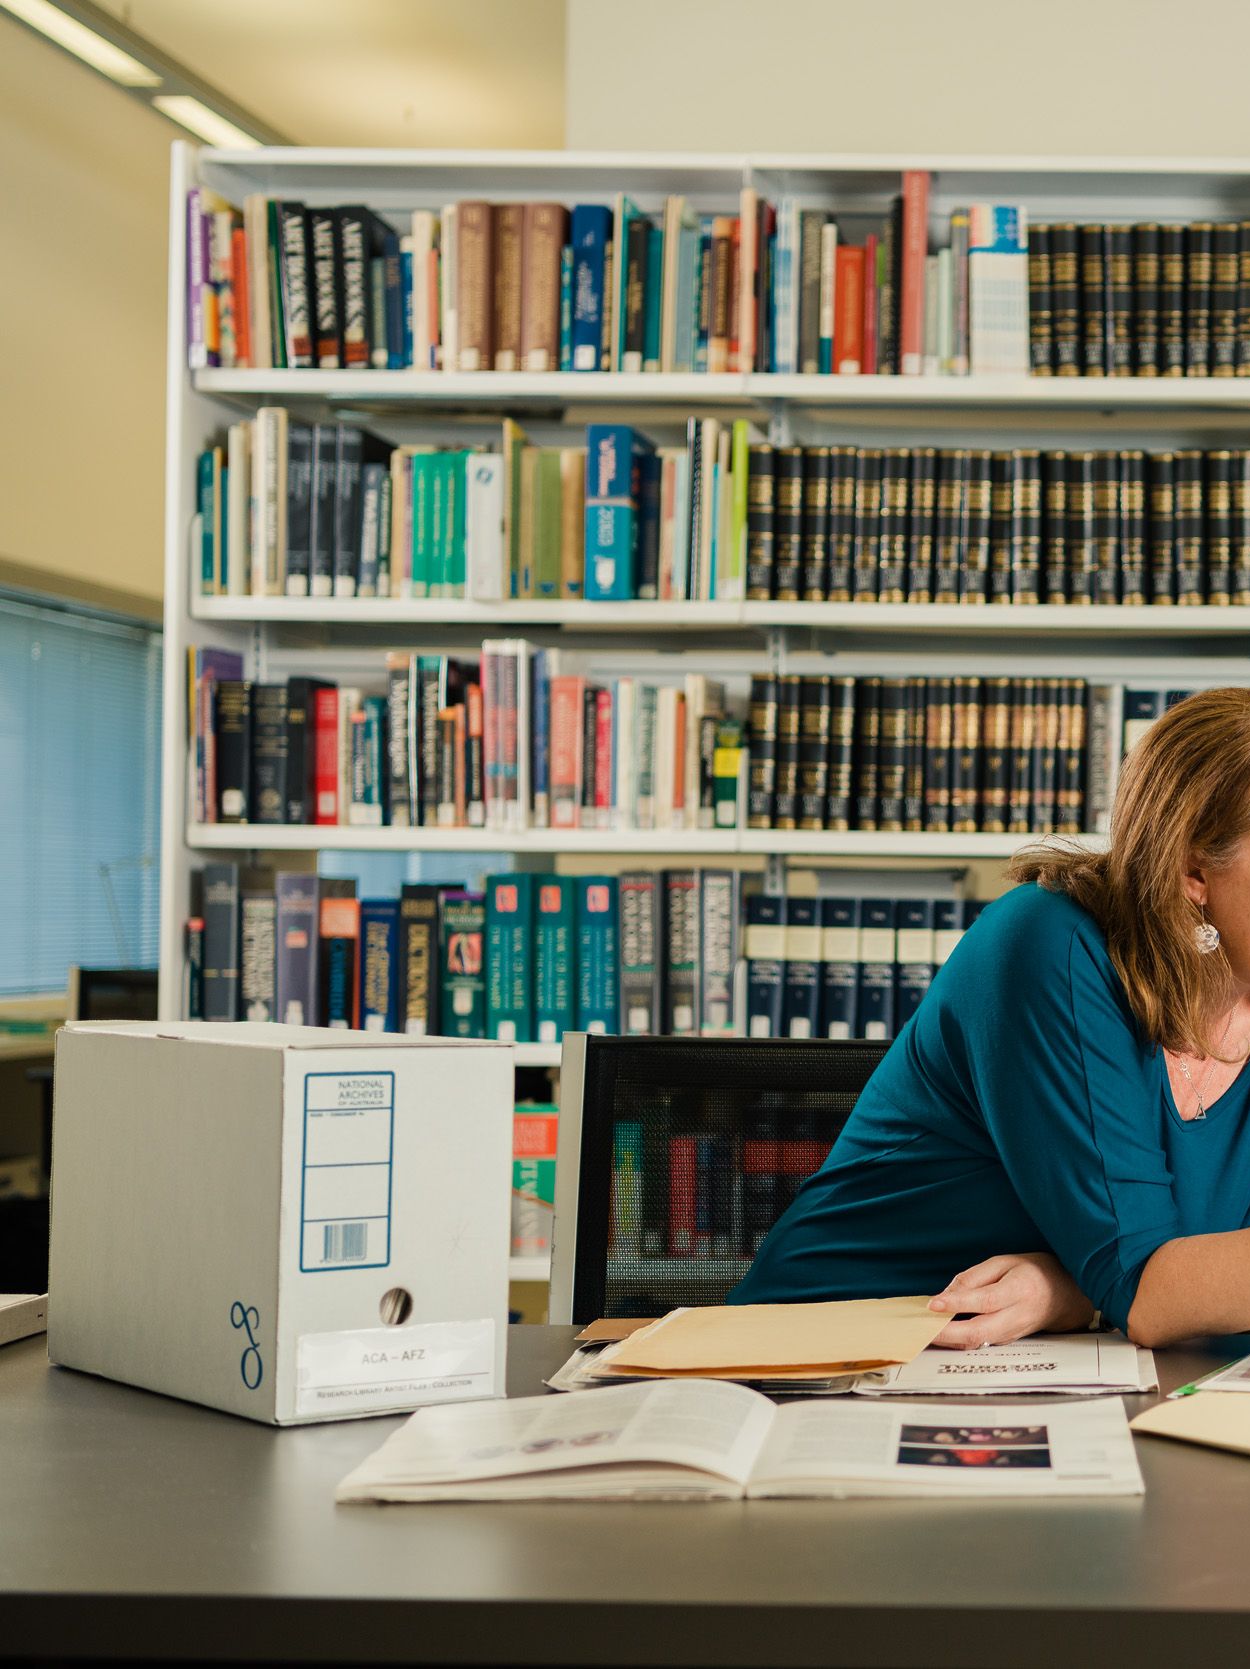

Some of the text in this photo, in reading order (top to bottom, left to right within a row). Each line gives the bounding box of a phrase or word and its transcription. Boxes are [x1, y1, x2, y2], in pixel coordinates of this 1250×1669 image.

[338, 1080, 384, 1089] NATIONAL
[339, 1089, 384, 1099] ARCHIVES
[362, 1352, 388, 1364] ACA
[401, 1349, 425, 1361] AFZ
[317, 1389, 352, 1399] RESEARCH
[354, 1387, 383, 1396] LIBRARY
[432, 1379, 472, 1389] COLLECTION
